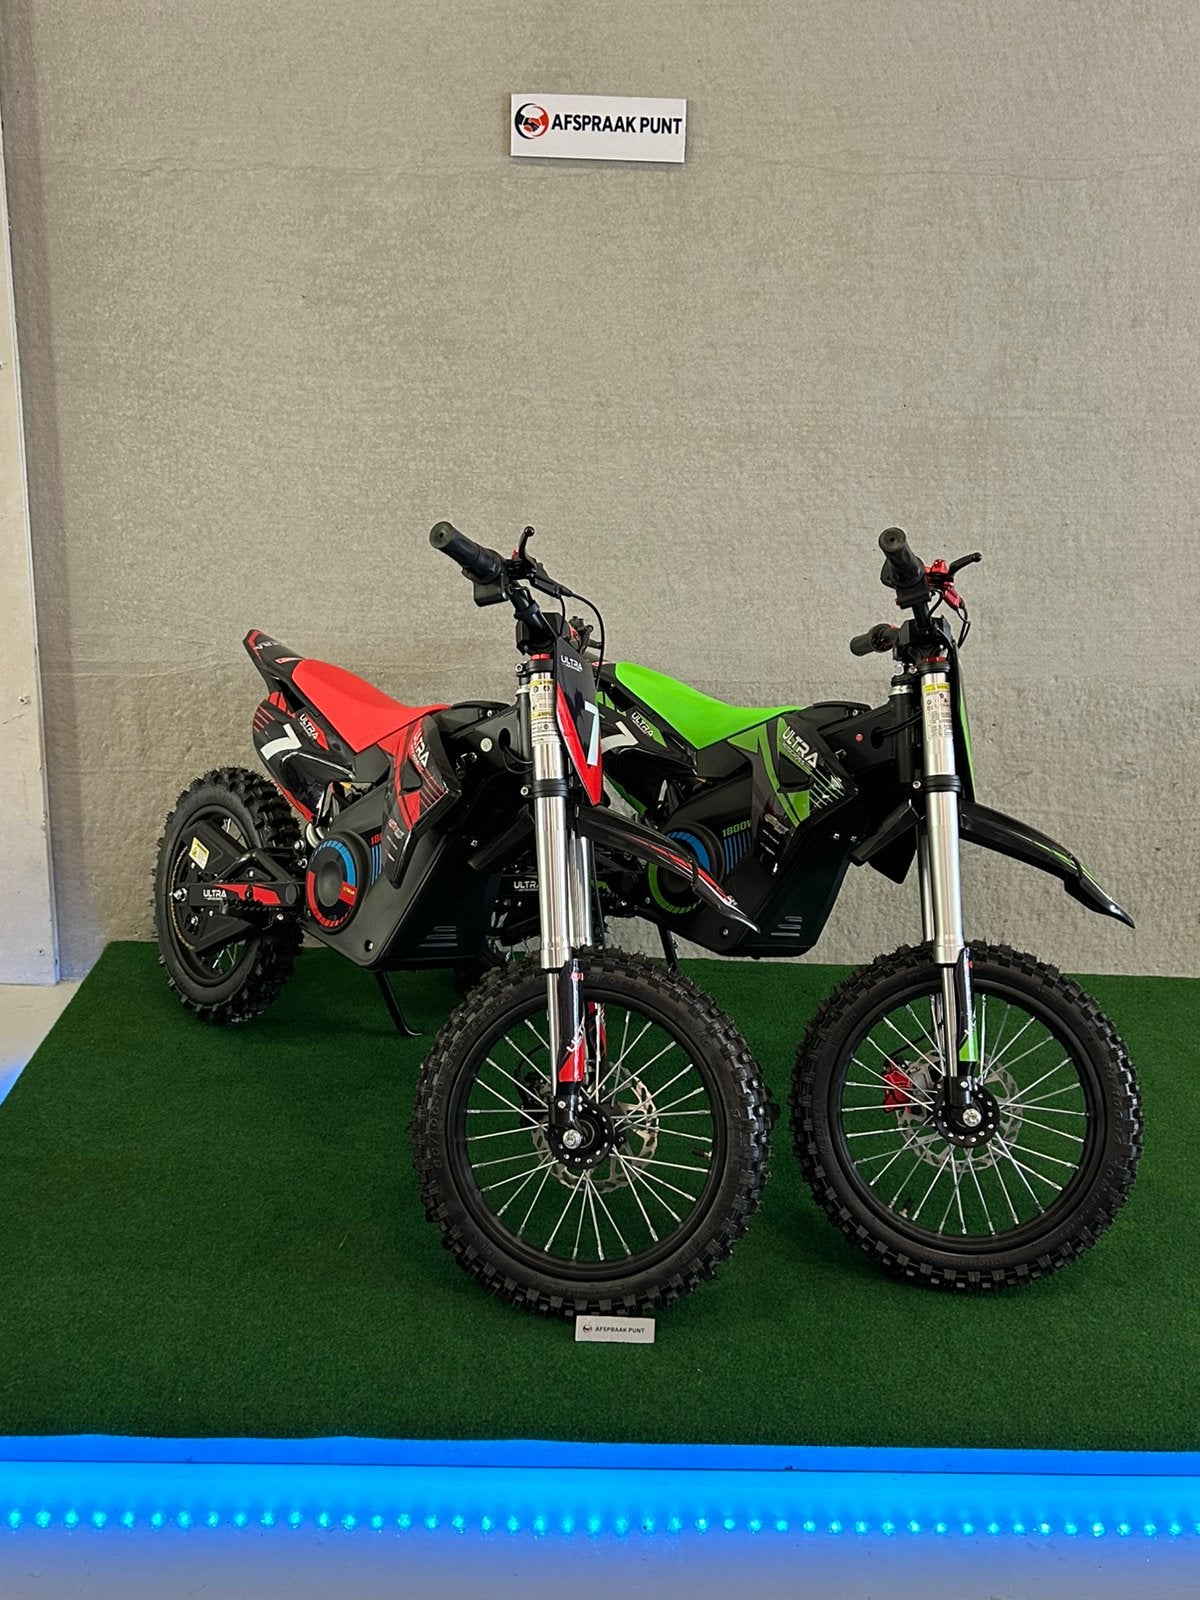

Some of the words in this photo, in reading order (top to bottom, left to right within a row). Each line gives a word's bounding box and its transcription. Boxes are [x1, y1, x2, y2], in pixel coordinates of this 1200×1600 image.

[551, 113, 637, 133] AFSPRAAK
[640, 117, 682, 134] PUNT
[560, 655, 583, 671] ULTRA
[299, 713, 319, 740] ULTRA
[631, 711, 655, 737] ULTRA
[782, 726, 819, 769] ULTRA
[203, 889, 227, 898] ULTRA
[513, 880, 538, 889] ULTR
